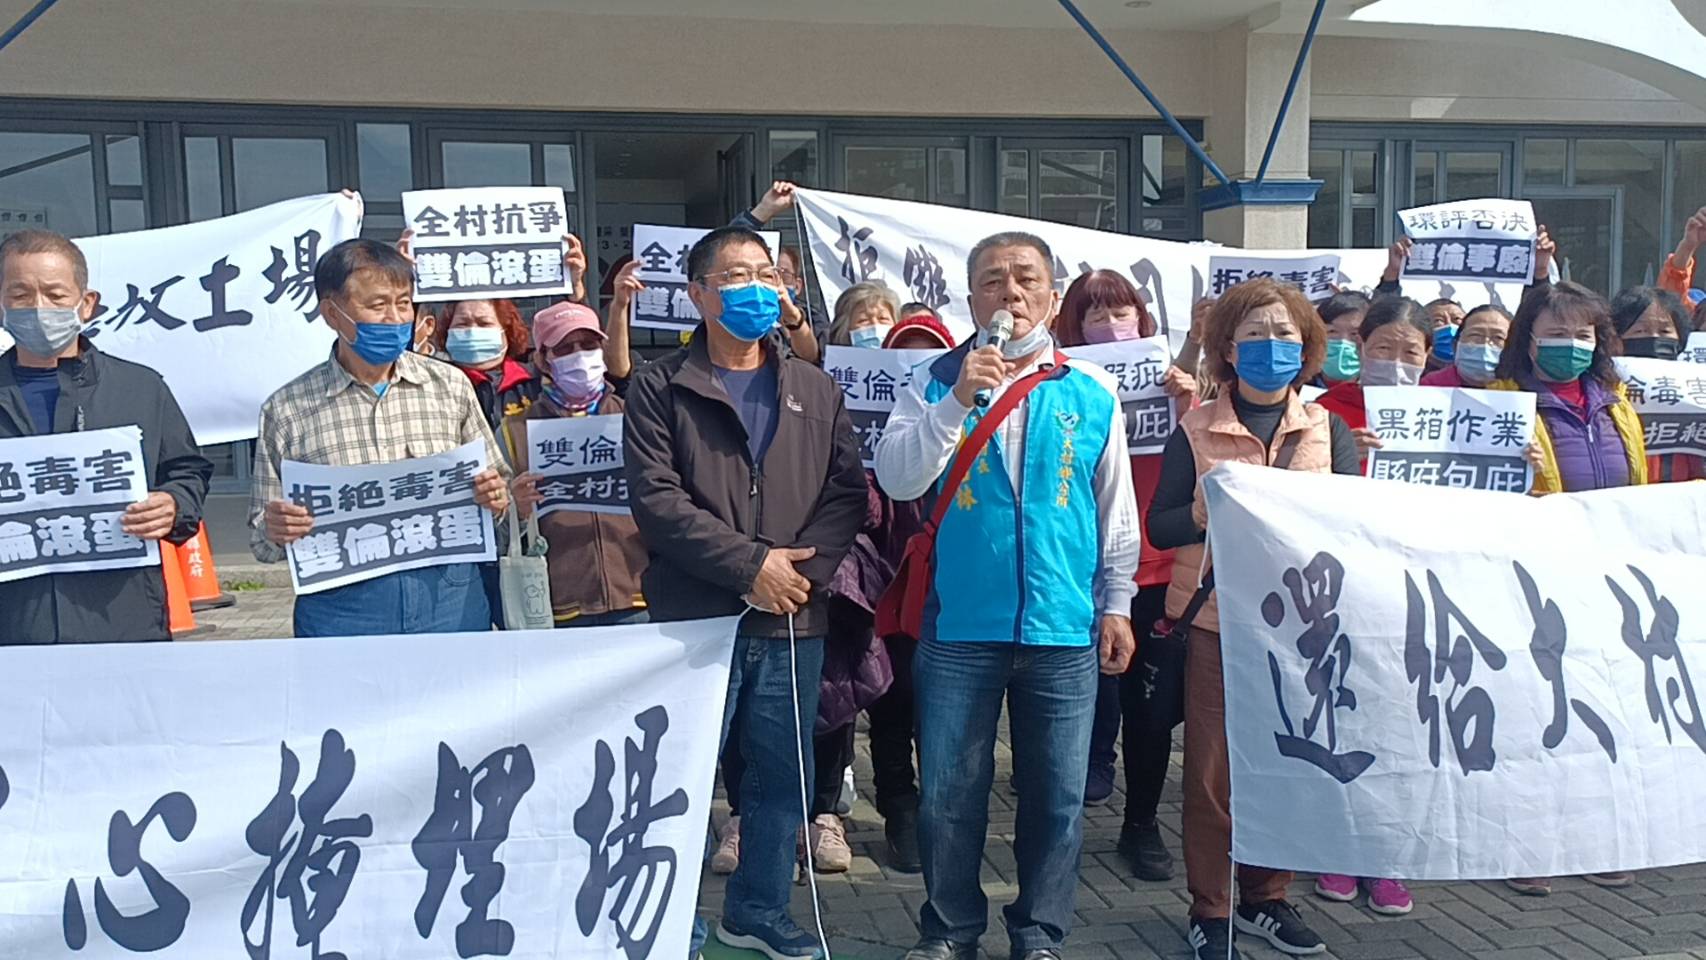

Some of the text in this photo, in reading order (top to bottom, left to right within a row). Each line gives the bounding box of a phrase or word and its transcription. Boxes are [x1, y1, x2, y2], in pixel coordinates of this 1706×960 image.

[413, 201, 563, 237] 全村抗爭
[1409, 209, 1530, 232] 環評否決
[416, 249, 563, 289] 雙倫滾蛋
[829, 366, 913, 402] 雙倫
[1375, 408, 1527, 447] 黑箱作業
[292, 504, 483, 578] 雙倫滾蛋
